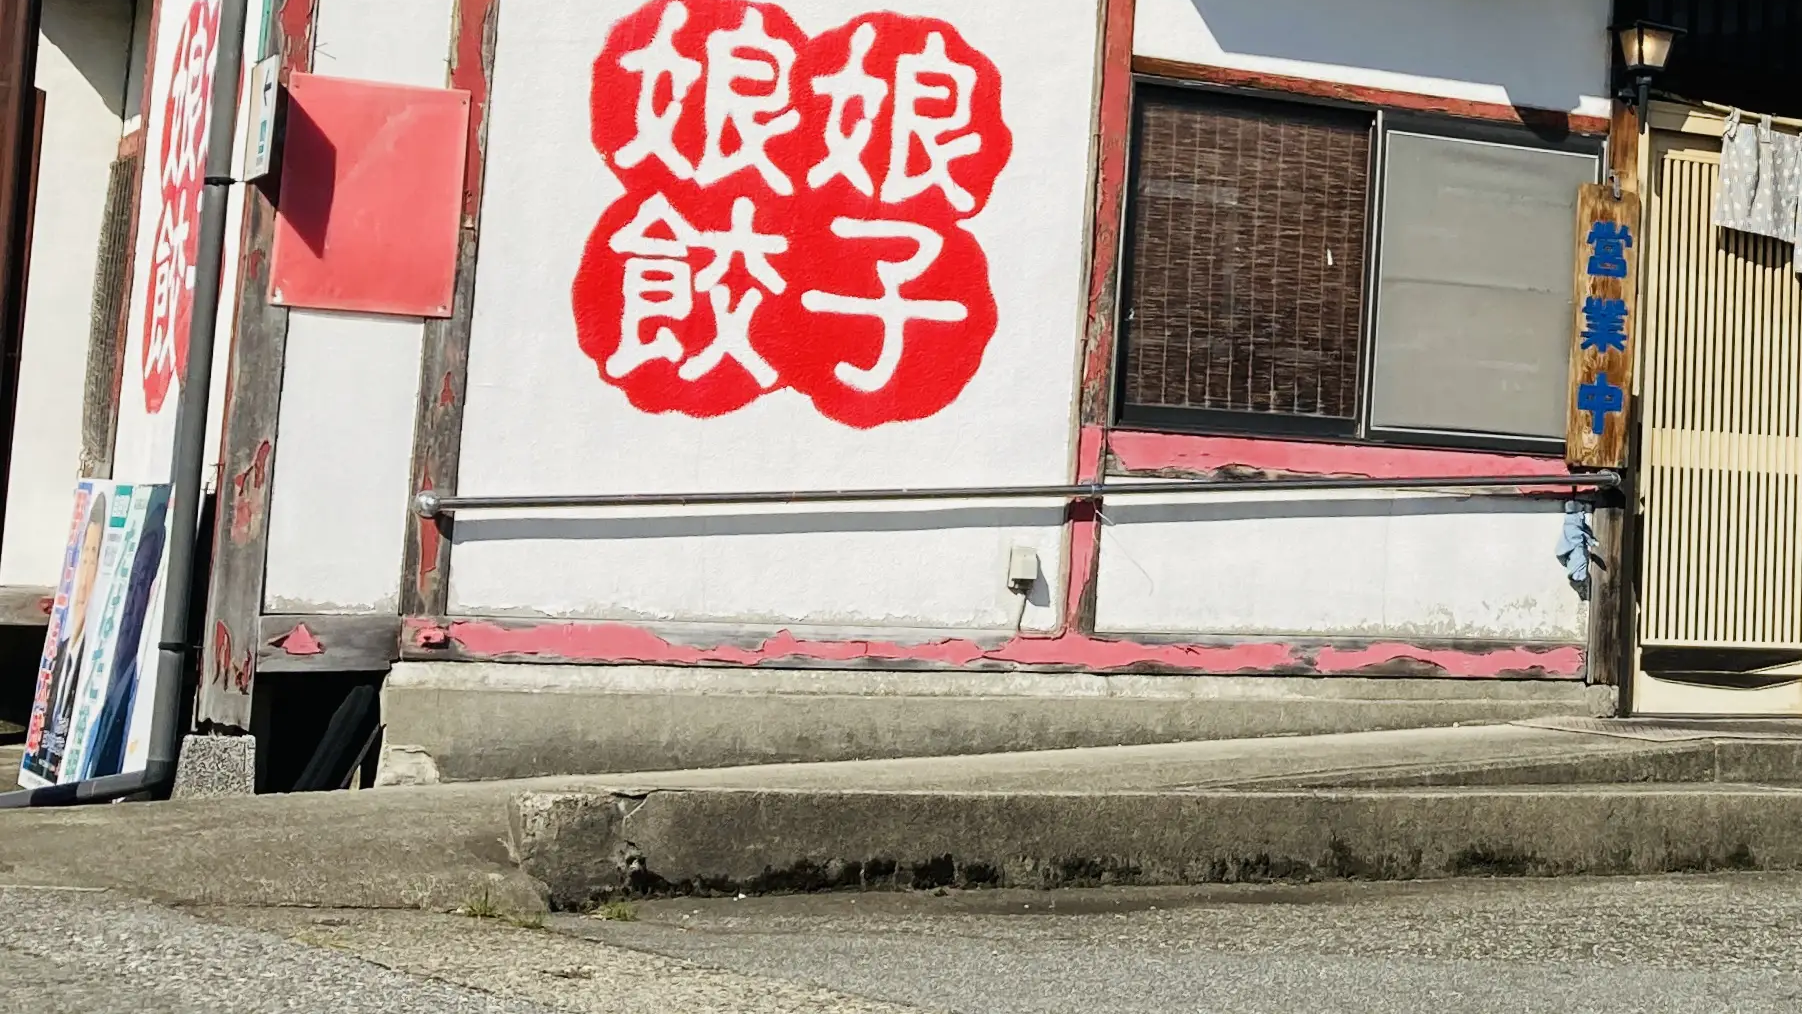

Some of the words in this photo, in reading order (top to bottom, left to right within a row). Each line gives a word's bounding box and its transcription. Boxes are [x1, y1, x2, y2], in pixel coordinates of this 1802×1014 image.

[614, 0, 983, 214] 娘娘
[604, 191, 969, 394] 餃子
[1577, 220, 1633, 435] 営業中
